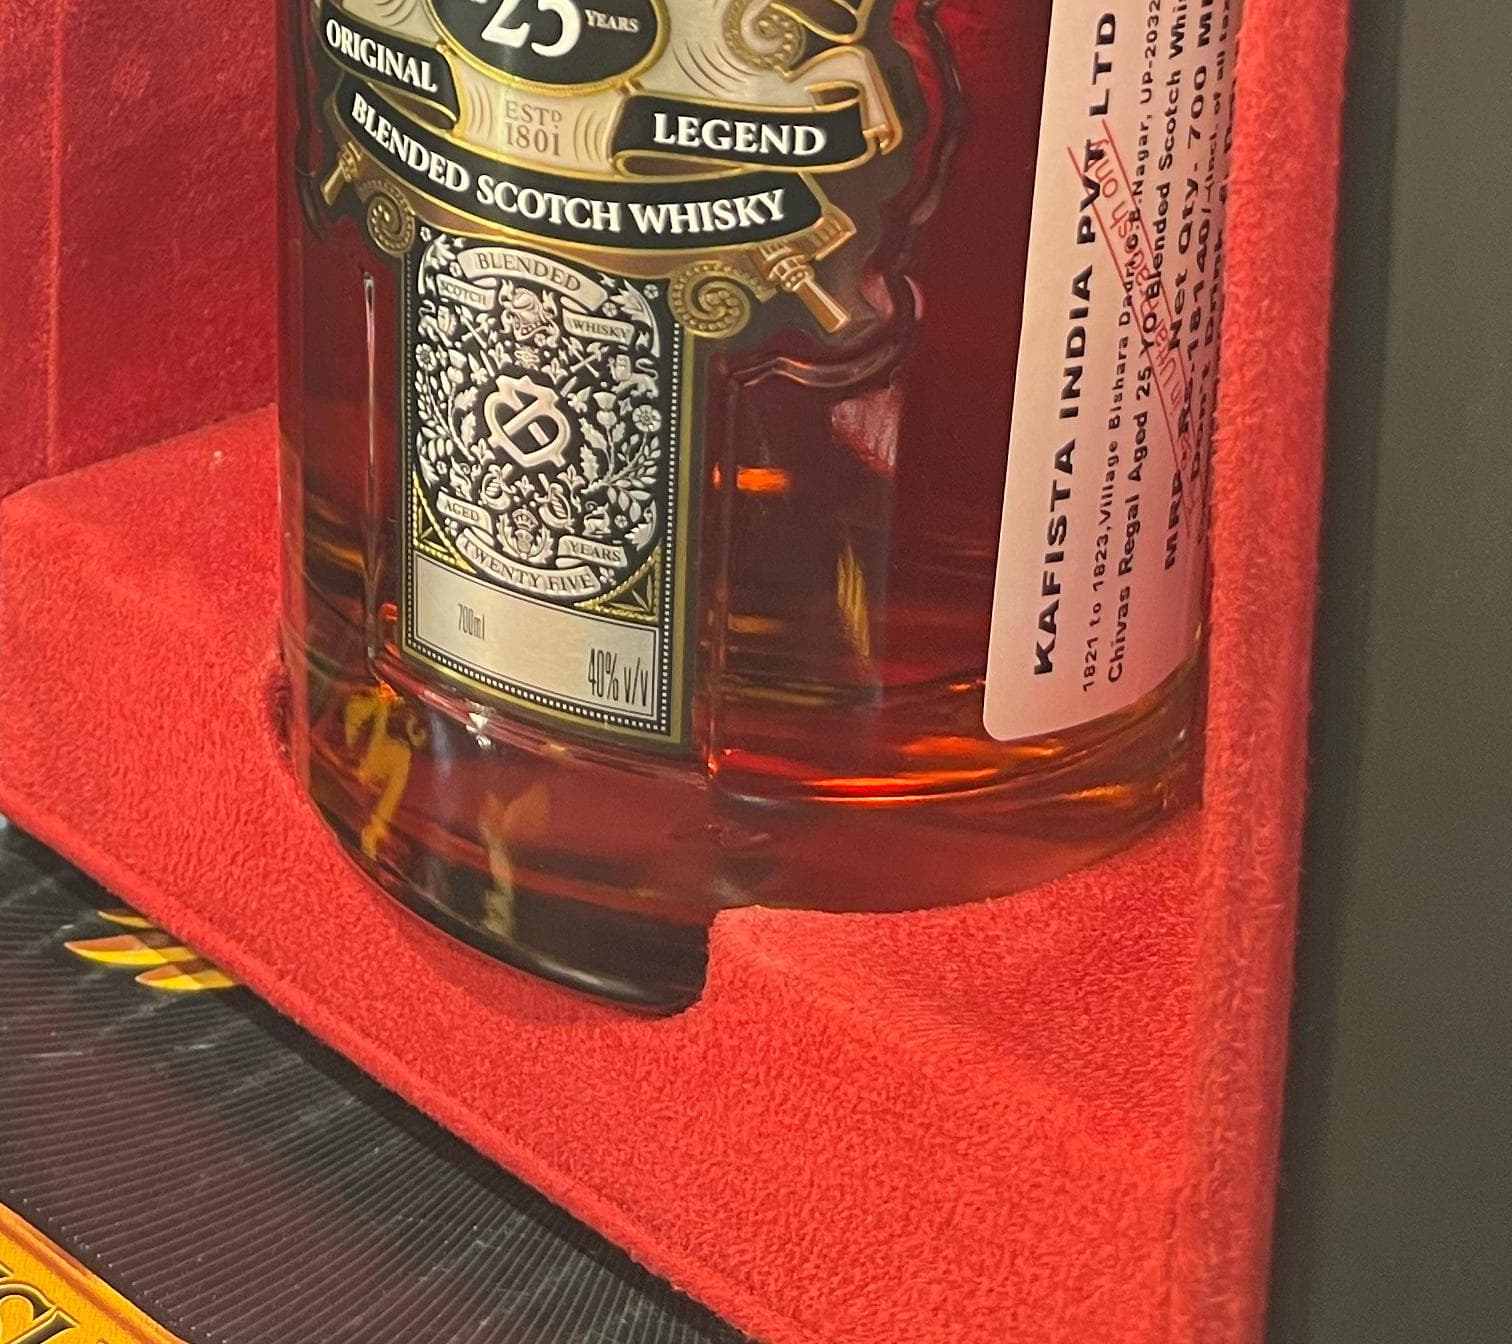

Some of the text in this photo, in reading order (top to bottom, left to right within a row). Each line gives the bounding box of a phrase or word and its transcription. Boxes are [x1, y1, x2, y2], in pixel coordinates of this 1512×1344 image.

[585, 9, 640, 35] YEARS
[324, 19, 440, 93] ORIGINAL
[652, 112, 827, 157] LEGEND
[1157, 69, 1182, 171] Scotch
[350, 92, 786, 235] BLENDED SCOTCH WHISKY
[1168, 268, 1188, 351] Net
[1187, 65, 1207, 150] 700
[1145, 181, 1171, 300] Blended
[438, 279, 488, 307] SCOTCH
[477, 252, 583, 295] BLENDED
[571, 317, 631, 340] WHISKY
[1033, 12, 1116, 675] KAFISTA INDIA PVT LTD
[1136, 366, 1152, 401] 25
[1127, 410, 1148, 482] Aged
[443, 497, 480, 523] AGED
[1117, 494, 1141, 576] Regal
[458, 536, 598, 593] TWENTY FIVE
[567, 538, 622, 565] YEARS
[457, 602, 486, 642] 700ml
[1089, 602, 1102, 628] to
[1107, 585, 1131, 683] Chivas
[587, 646, 650, 710] 40% v/v
[1082, 636, 1099, 693] 1821
